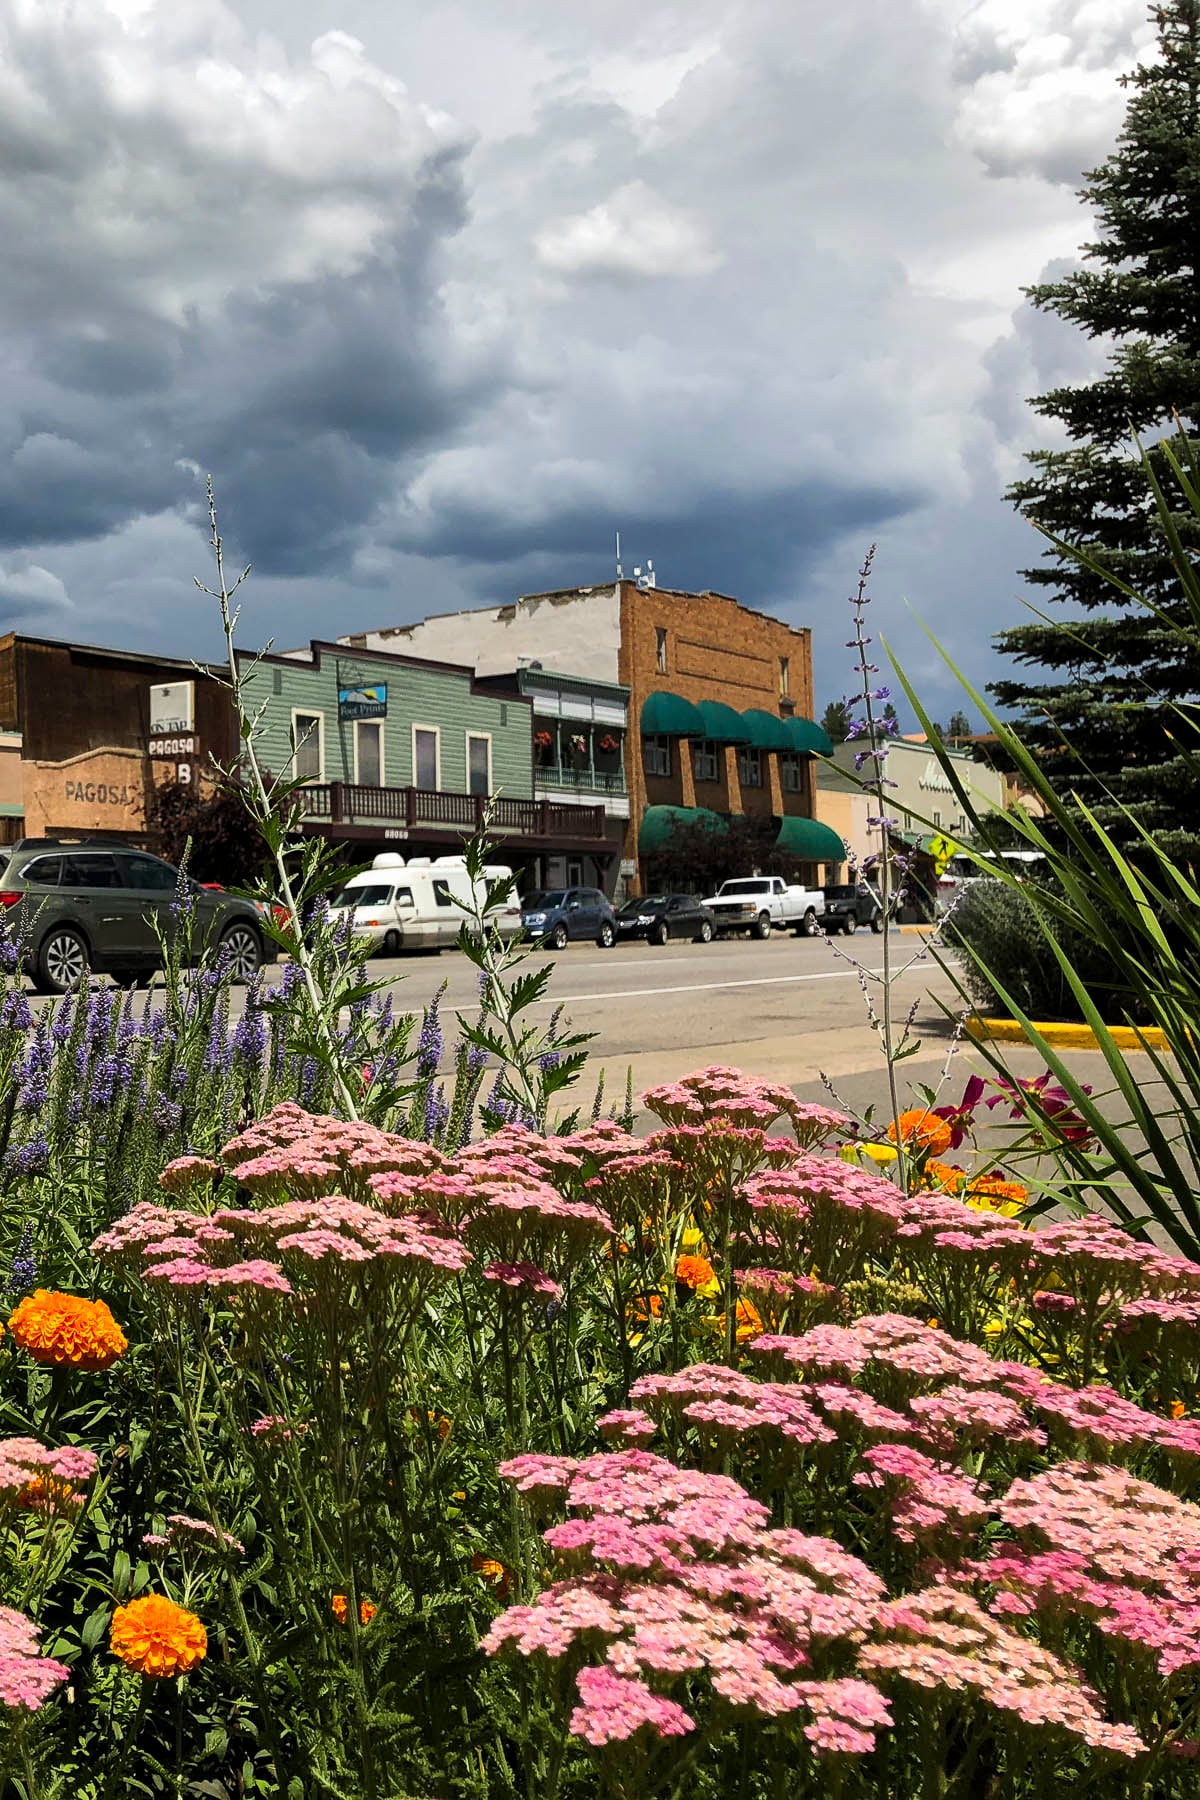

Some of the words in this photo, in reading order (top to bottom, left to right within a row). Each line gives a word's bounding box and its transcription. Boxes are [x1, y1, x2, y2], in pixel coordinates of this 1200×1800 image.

[149, 738, 194, 756] PAGOSA
[177, 763, 192, 785] B
[65, 780, 128, 806] PAGOSA
